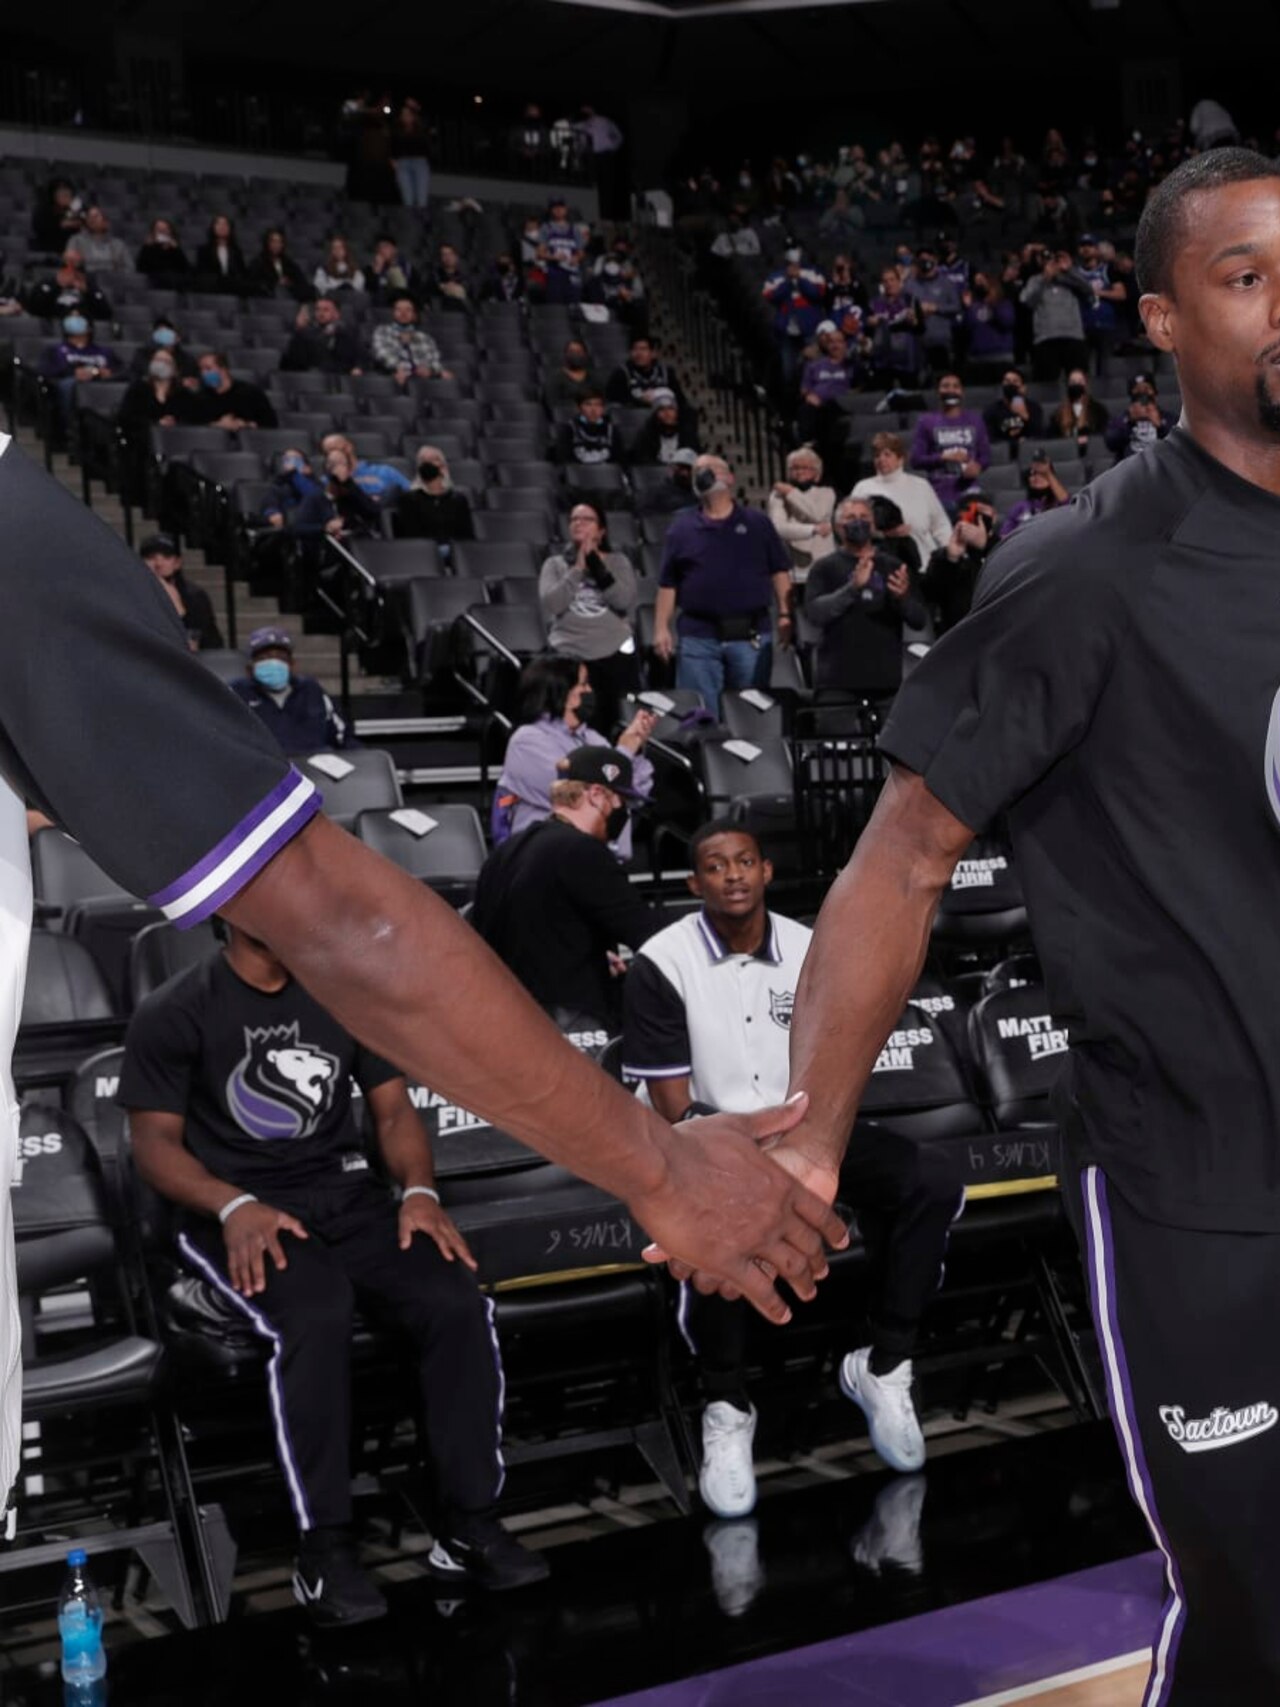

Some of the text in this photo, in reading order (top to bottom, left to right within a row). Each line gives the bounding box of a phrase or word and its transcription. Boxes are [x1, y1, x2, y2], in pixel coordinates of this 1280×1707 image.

[563, 1029, 608, 1047] ESS
[997, 1015, 1052, 1038] MATT
[1027, 1029, 1069, 1053] FIR
[991, 1141, 1052, 1171] KINGS
[568, 1218, 632, 1250] KINGS
[1159, 1401, 1279, 1450] Sactown
